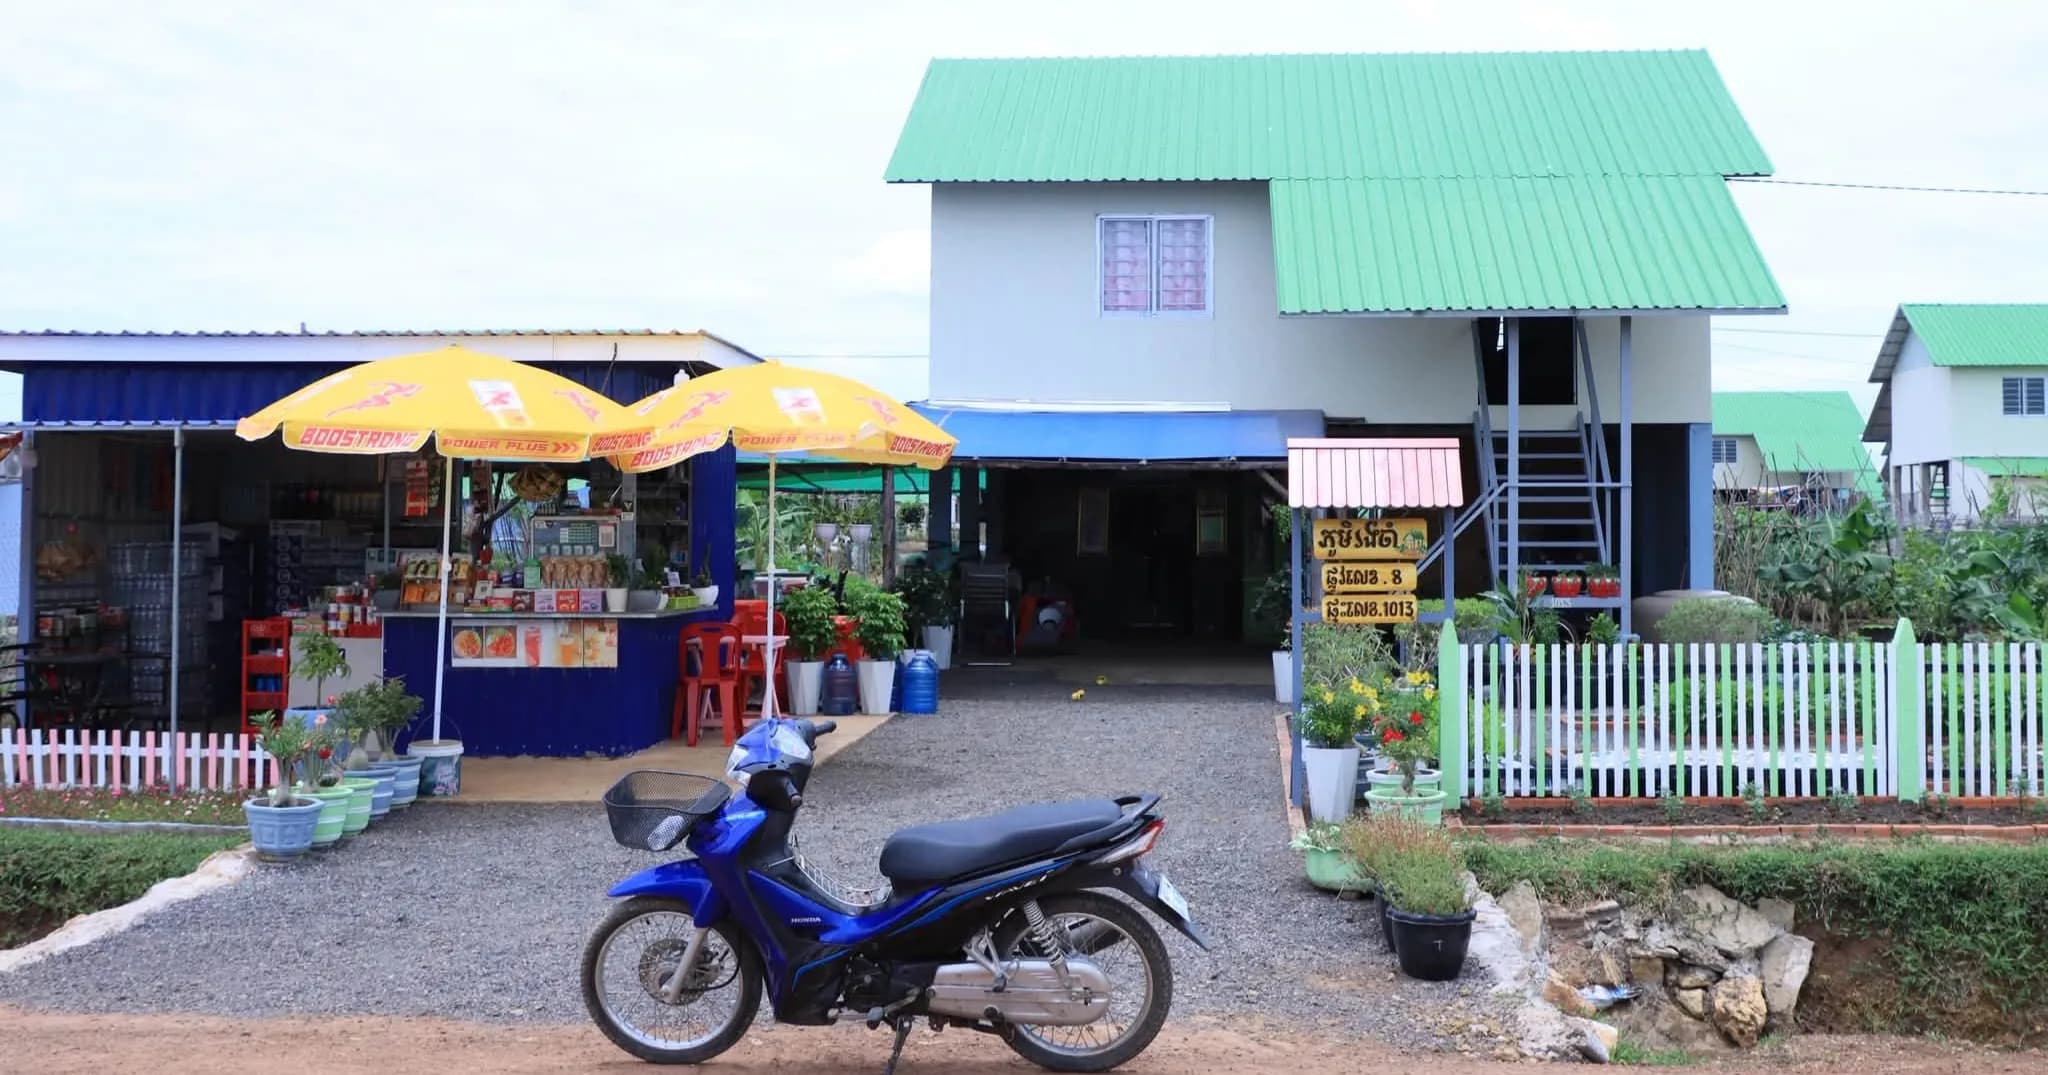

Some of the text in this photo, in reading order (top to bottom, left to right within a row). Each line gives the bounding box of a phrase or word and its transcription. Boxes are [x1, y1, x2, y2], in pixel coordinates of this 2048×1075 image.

[300, 427, 420, 449] BOOSTRONG
[442, 437, 549, 452] POWER PLUS
[739, 433, 798, 446] POWER
[890, 435, 953, 457] BOOSTRONG
[1391, 569, 1402, 585] 8
[791, 916, 822, 924] HONDA
